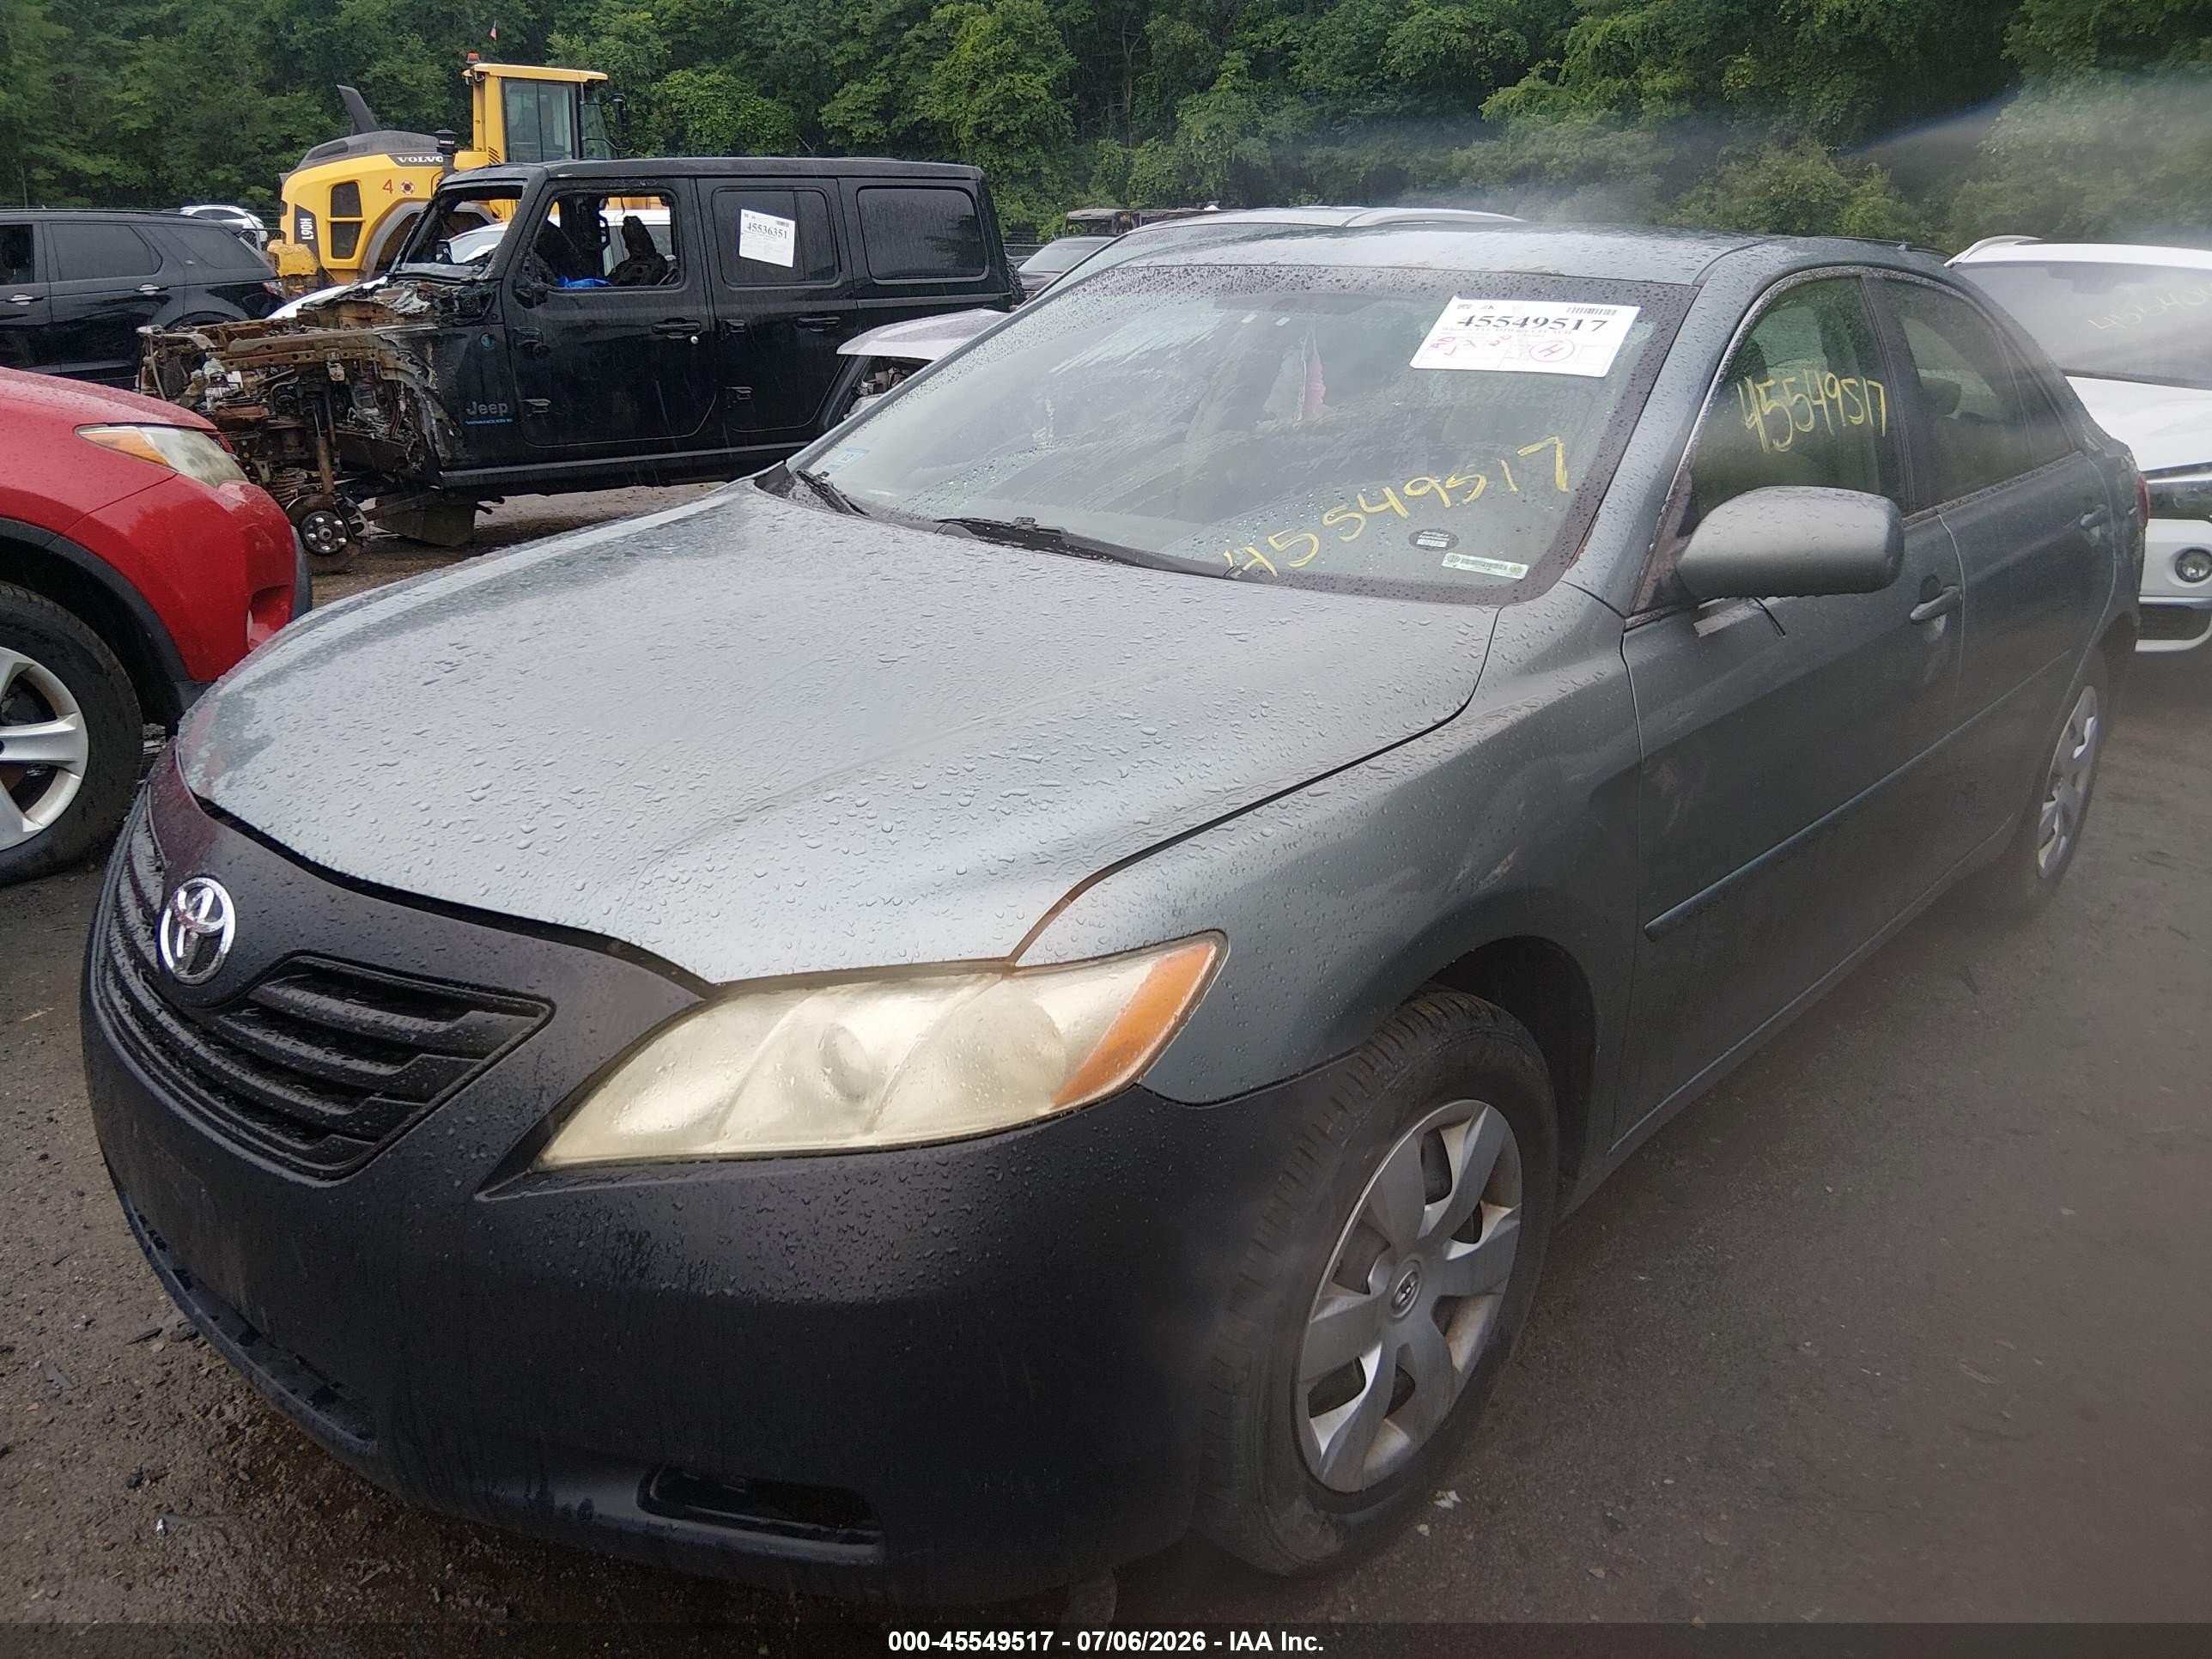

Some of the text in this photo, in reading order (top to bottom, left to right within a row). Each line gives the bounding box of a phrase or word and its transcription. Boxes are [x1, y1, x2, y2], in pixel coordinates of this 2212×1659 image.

[397, 155, 444, 164] VOLVO
[381, 179, 394, 194] 4
[299, 217, 314, 240] L90H
[746, 222, 787, 240] 45536351
[1455, 314, 1608, 333] 45549517
[465, 400, 509, 417] Jeep
[1736, 368, 1887, 454] 45549517
[1222, 434, 1571, 578] 45549517
